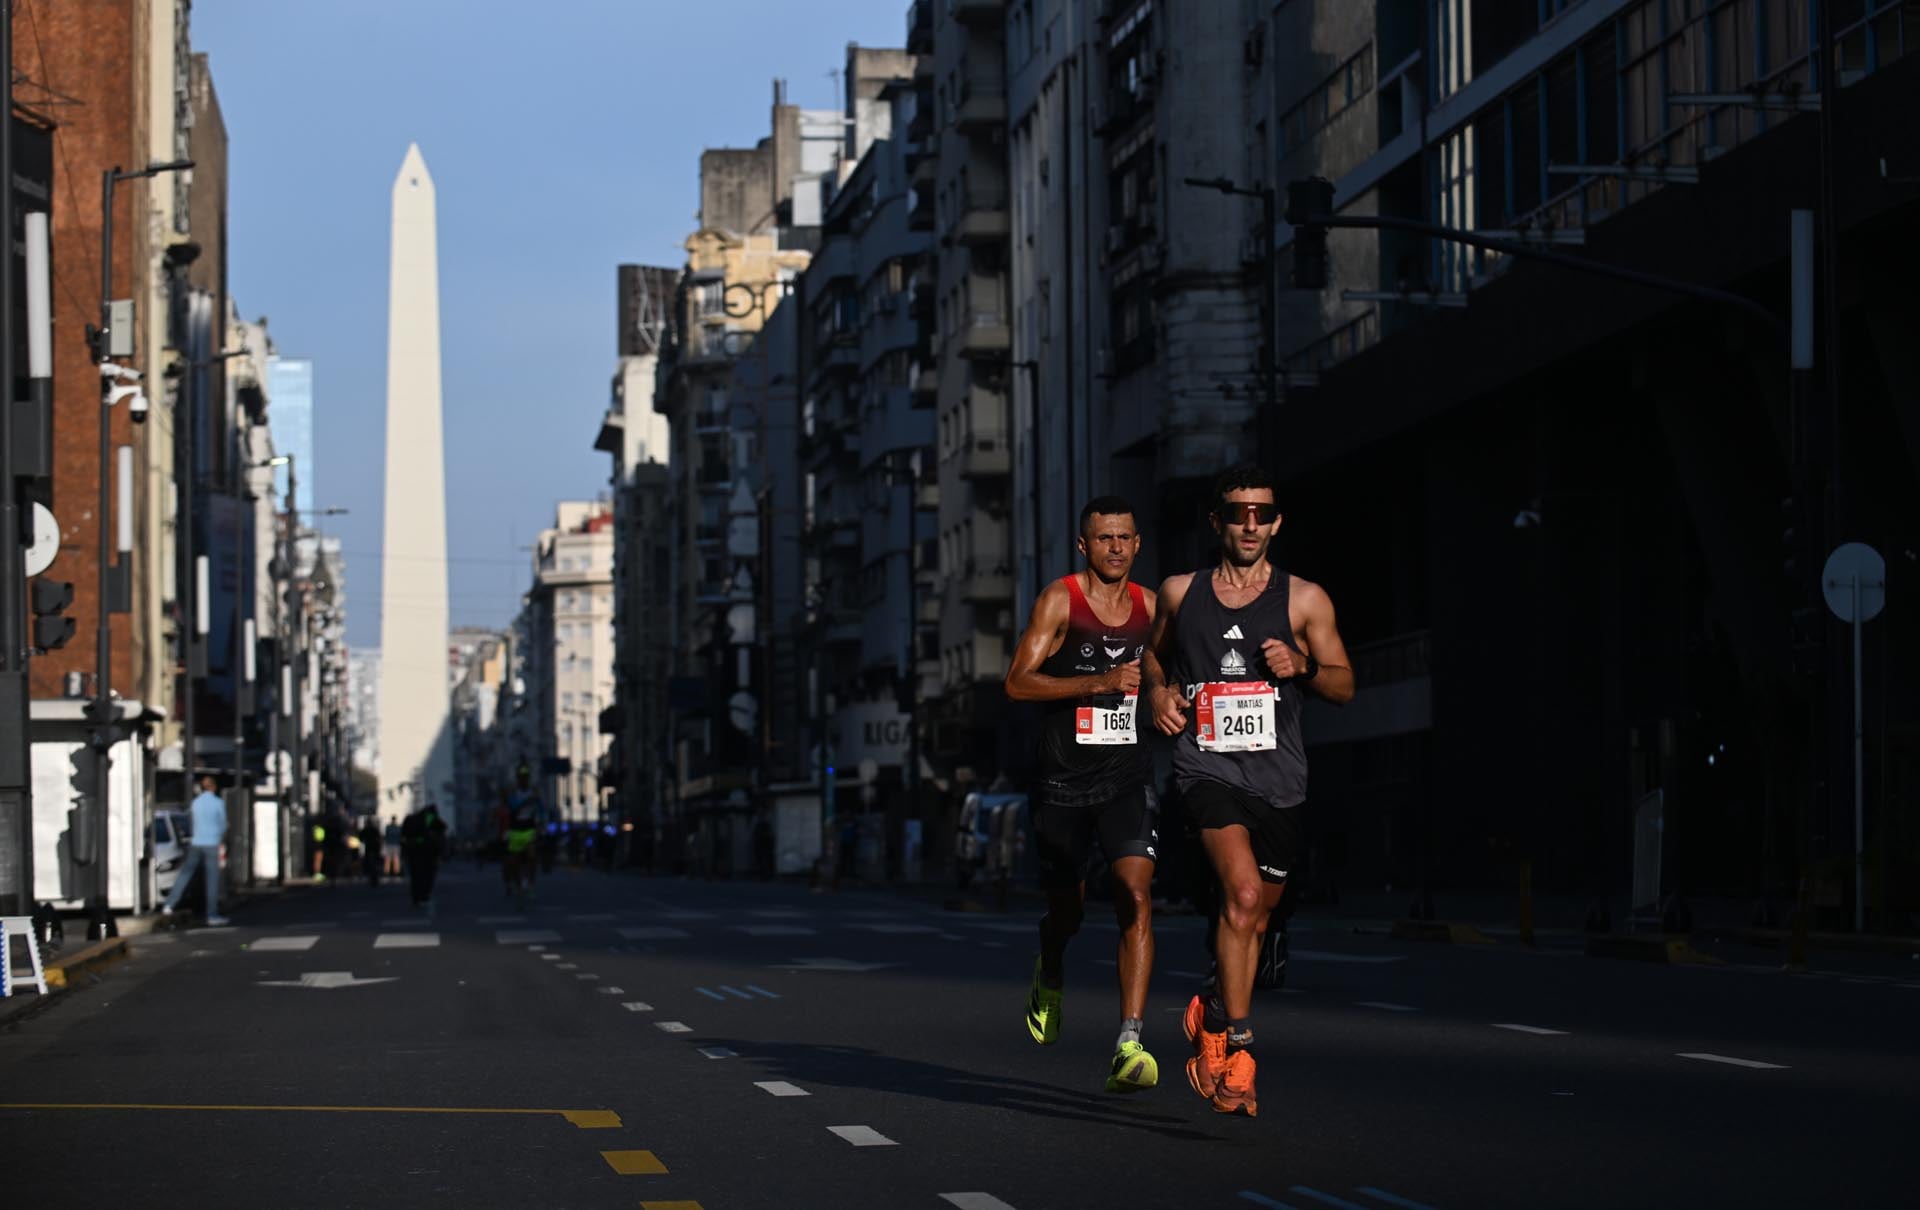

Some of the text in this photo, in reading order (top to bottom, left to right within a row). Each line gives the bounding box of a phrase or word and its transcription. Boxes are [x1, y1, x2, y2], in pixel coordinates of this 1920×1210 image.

[1200, 691, 1208, 705] C
[1237, 699, 1263, 709] MATIAS
[1102, 712, 1131, 731] 1652
[1223, 714, 1264, 736] 2461
